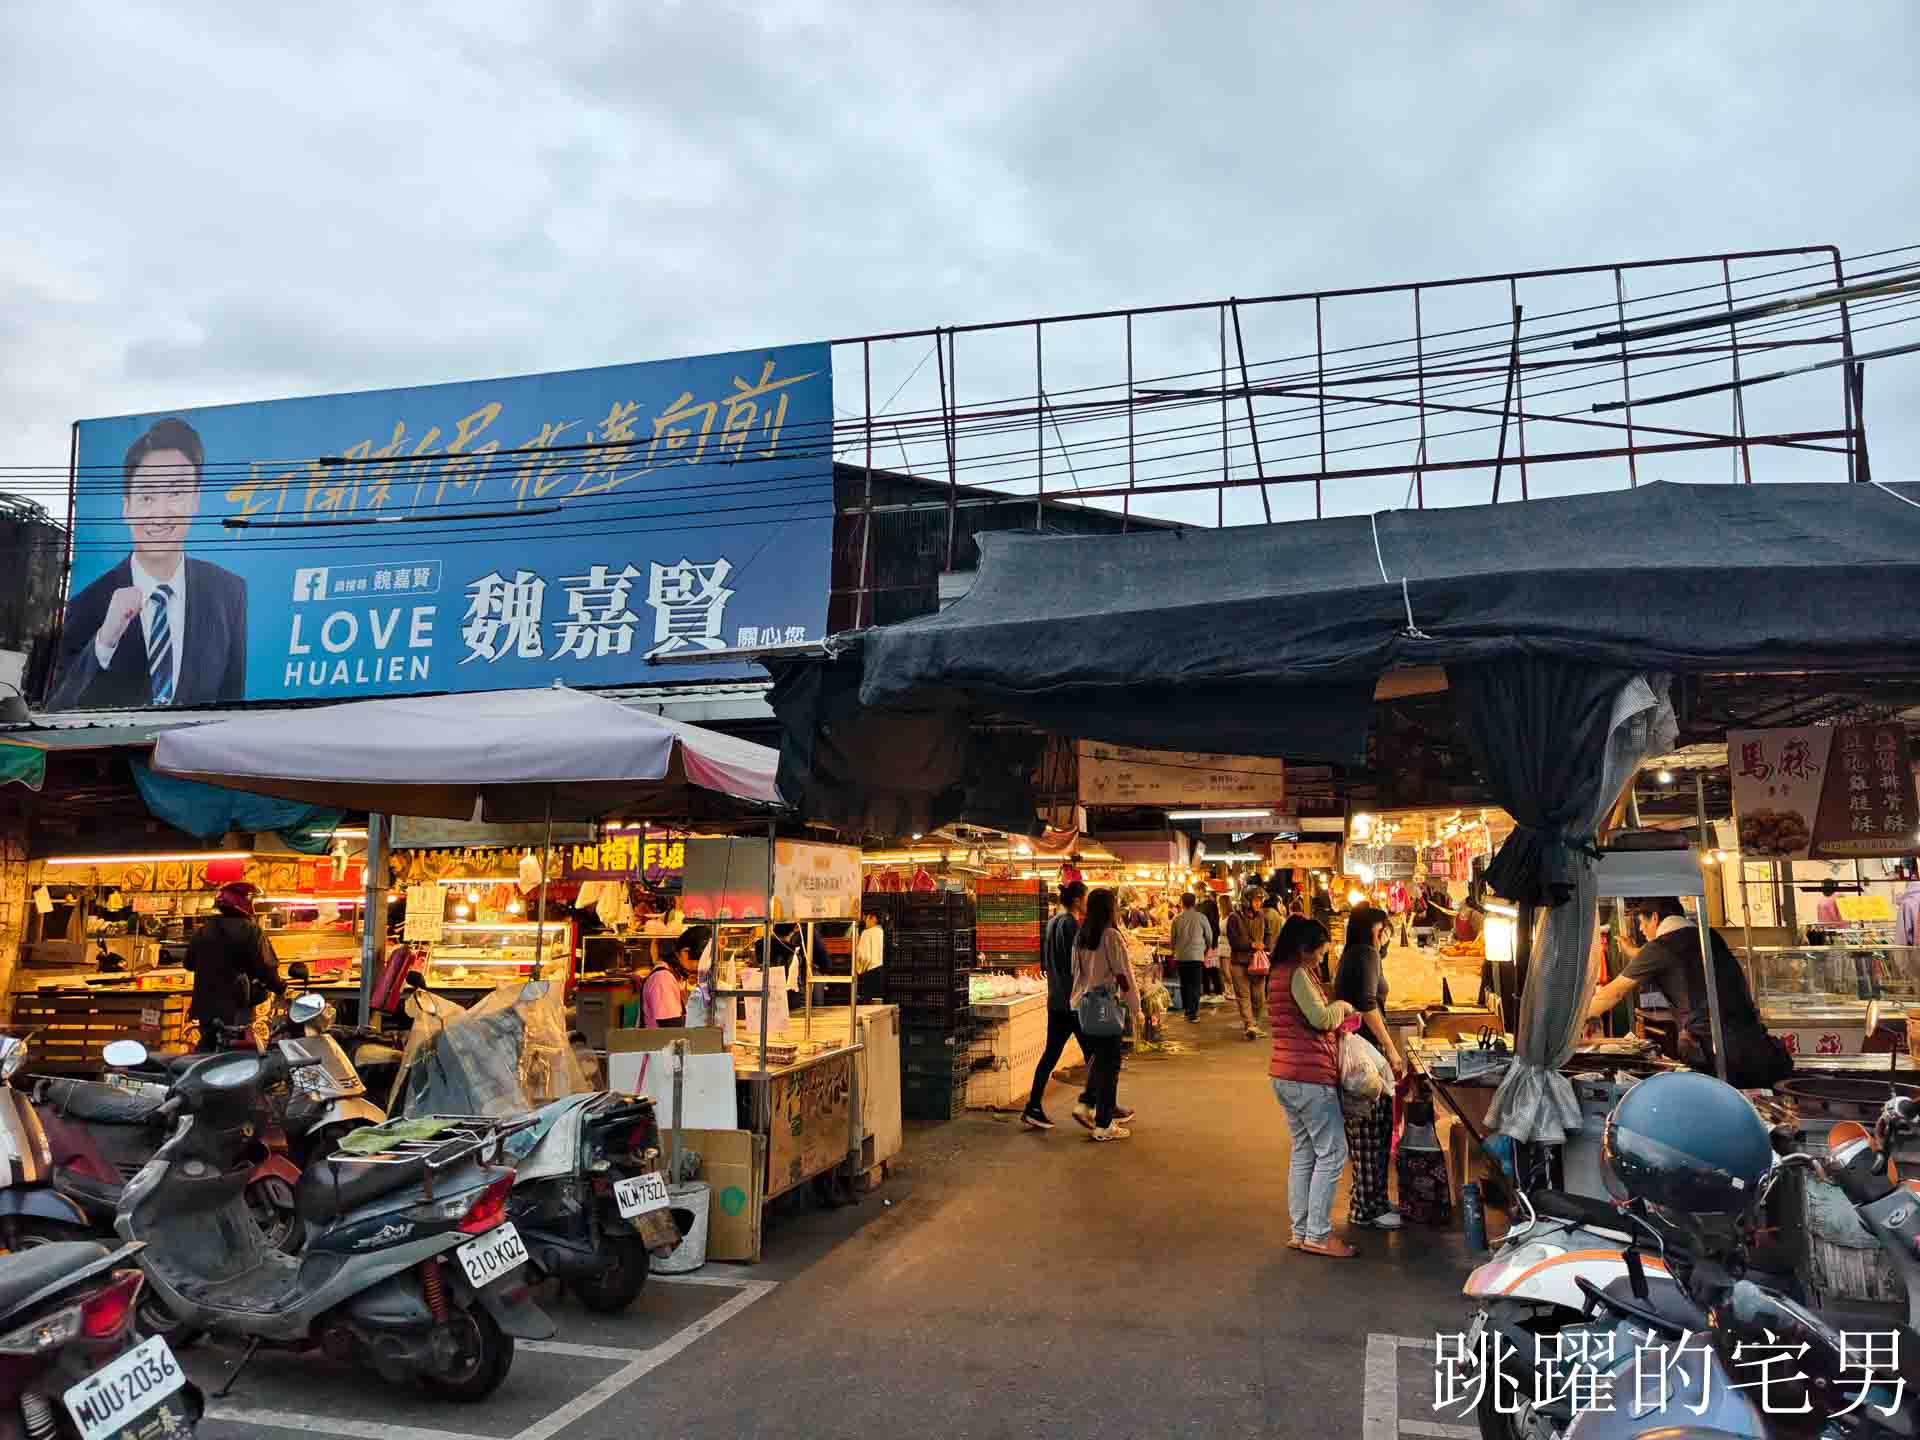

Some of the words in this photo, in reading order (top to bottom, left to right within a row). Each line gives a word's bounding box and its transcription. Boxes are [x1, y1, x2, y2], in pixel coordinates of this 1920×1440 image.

[374, 567, 432, 592] 魏嘉賢
[458, 555, 735, 664] 魏嘉賢
[289, 606, 436, 654] LOVE
[284, 655, 430, 687] HUALIEN
